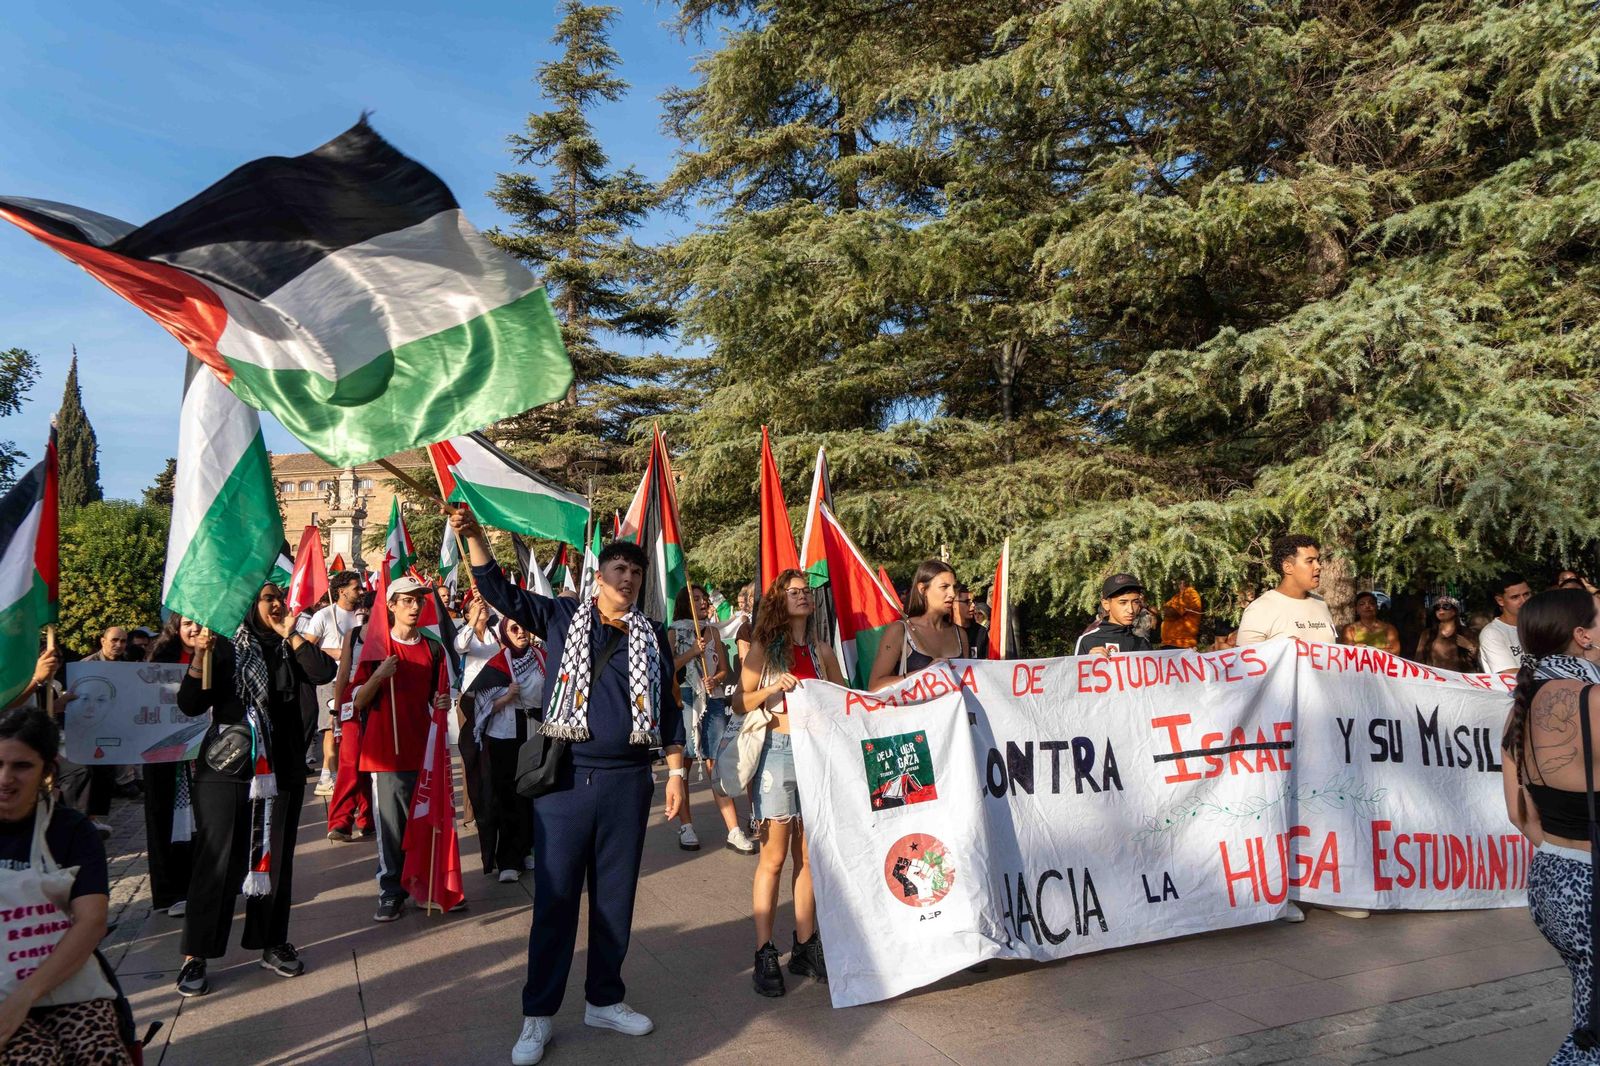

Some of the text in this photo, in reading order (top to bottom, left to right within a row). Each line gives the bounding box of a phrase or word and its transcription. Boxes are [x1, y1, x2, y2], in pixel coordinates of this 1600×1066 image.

[1012, 663, 1045, 697] DE
[1077, 648, 1267, 694] ESTUDIANTES
[897, 753, 920, 769] GAZA
[969, 704, 1503, 798] ONTRA ISRAE Y SU MISIL
[1141, 871, 1180, 904] LA
